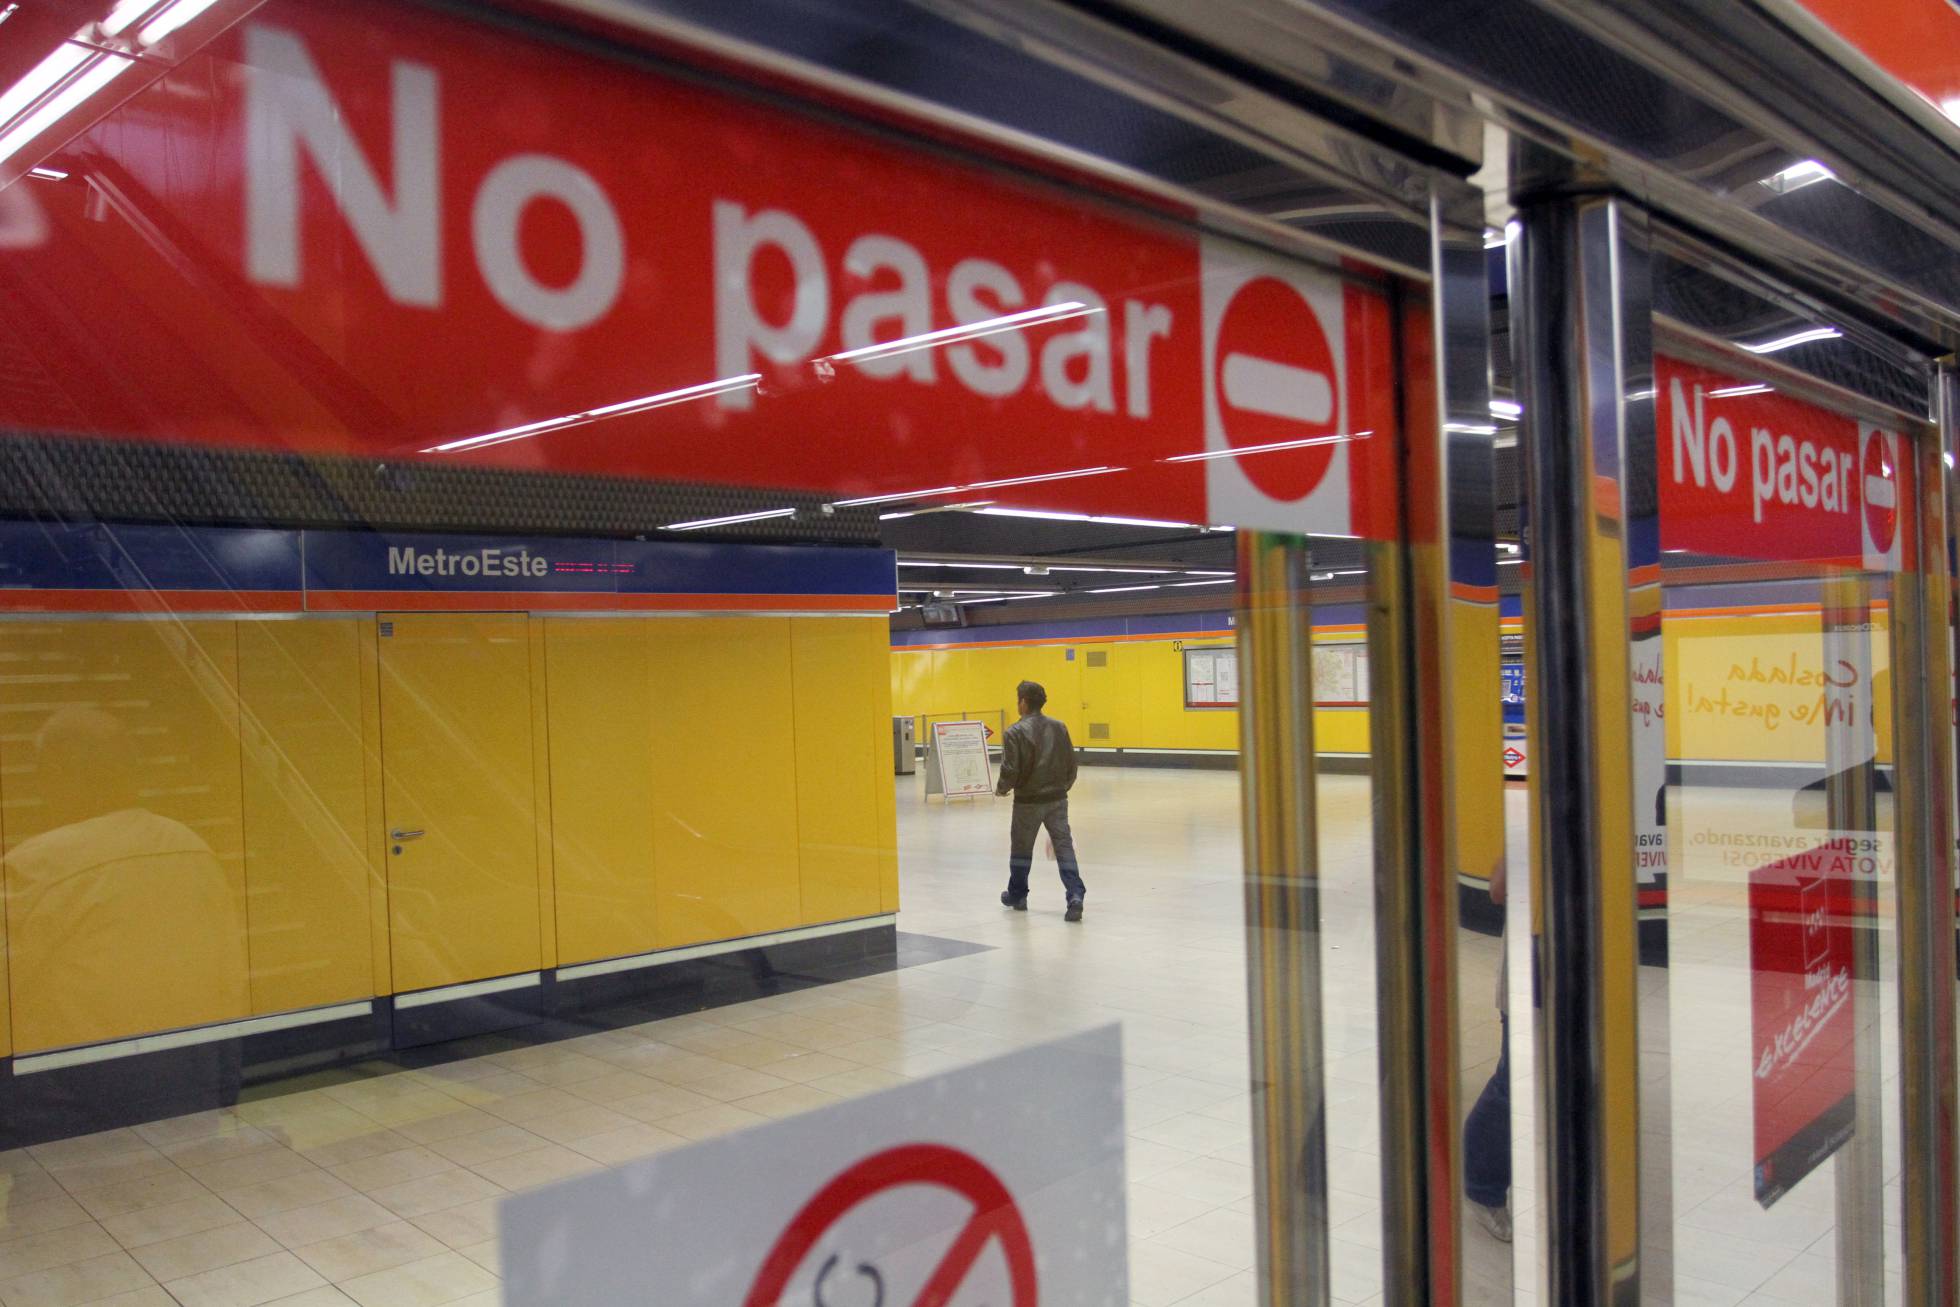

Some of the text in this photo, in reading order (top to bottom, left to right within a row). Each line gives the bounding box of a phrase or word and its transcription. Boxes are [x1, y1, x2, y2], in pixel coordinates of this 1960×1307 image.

[243, 24, 1173, 420] No pasar
[1670, 376, 1853, 524] No pasar
[388, 546, 548, 577] MetroEste
